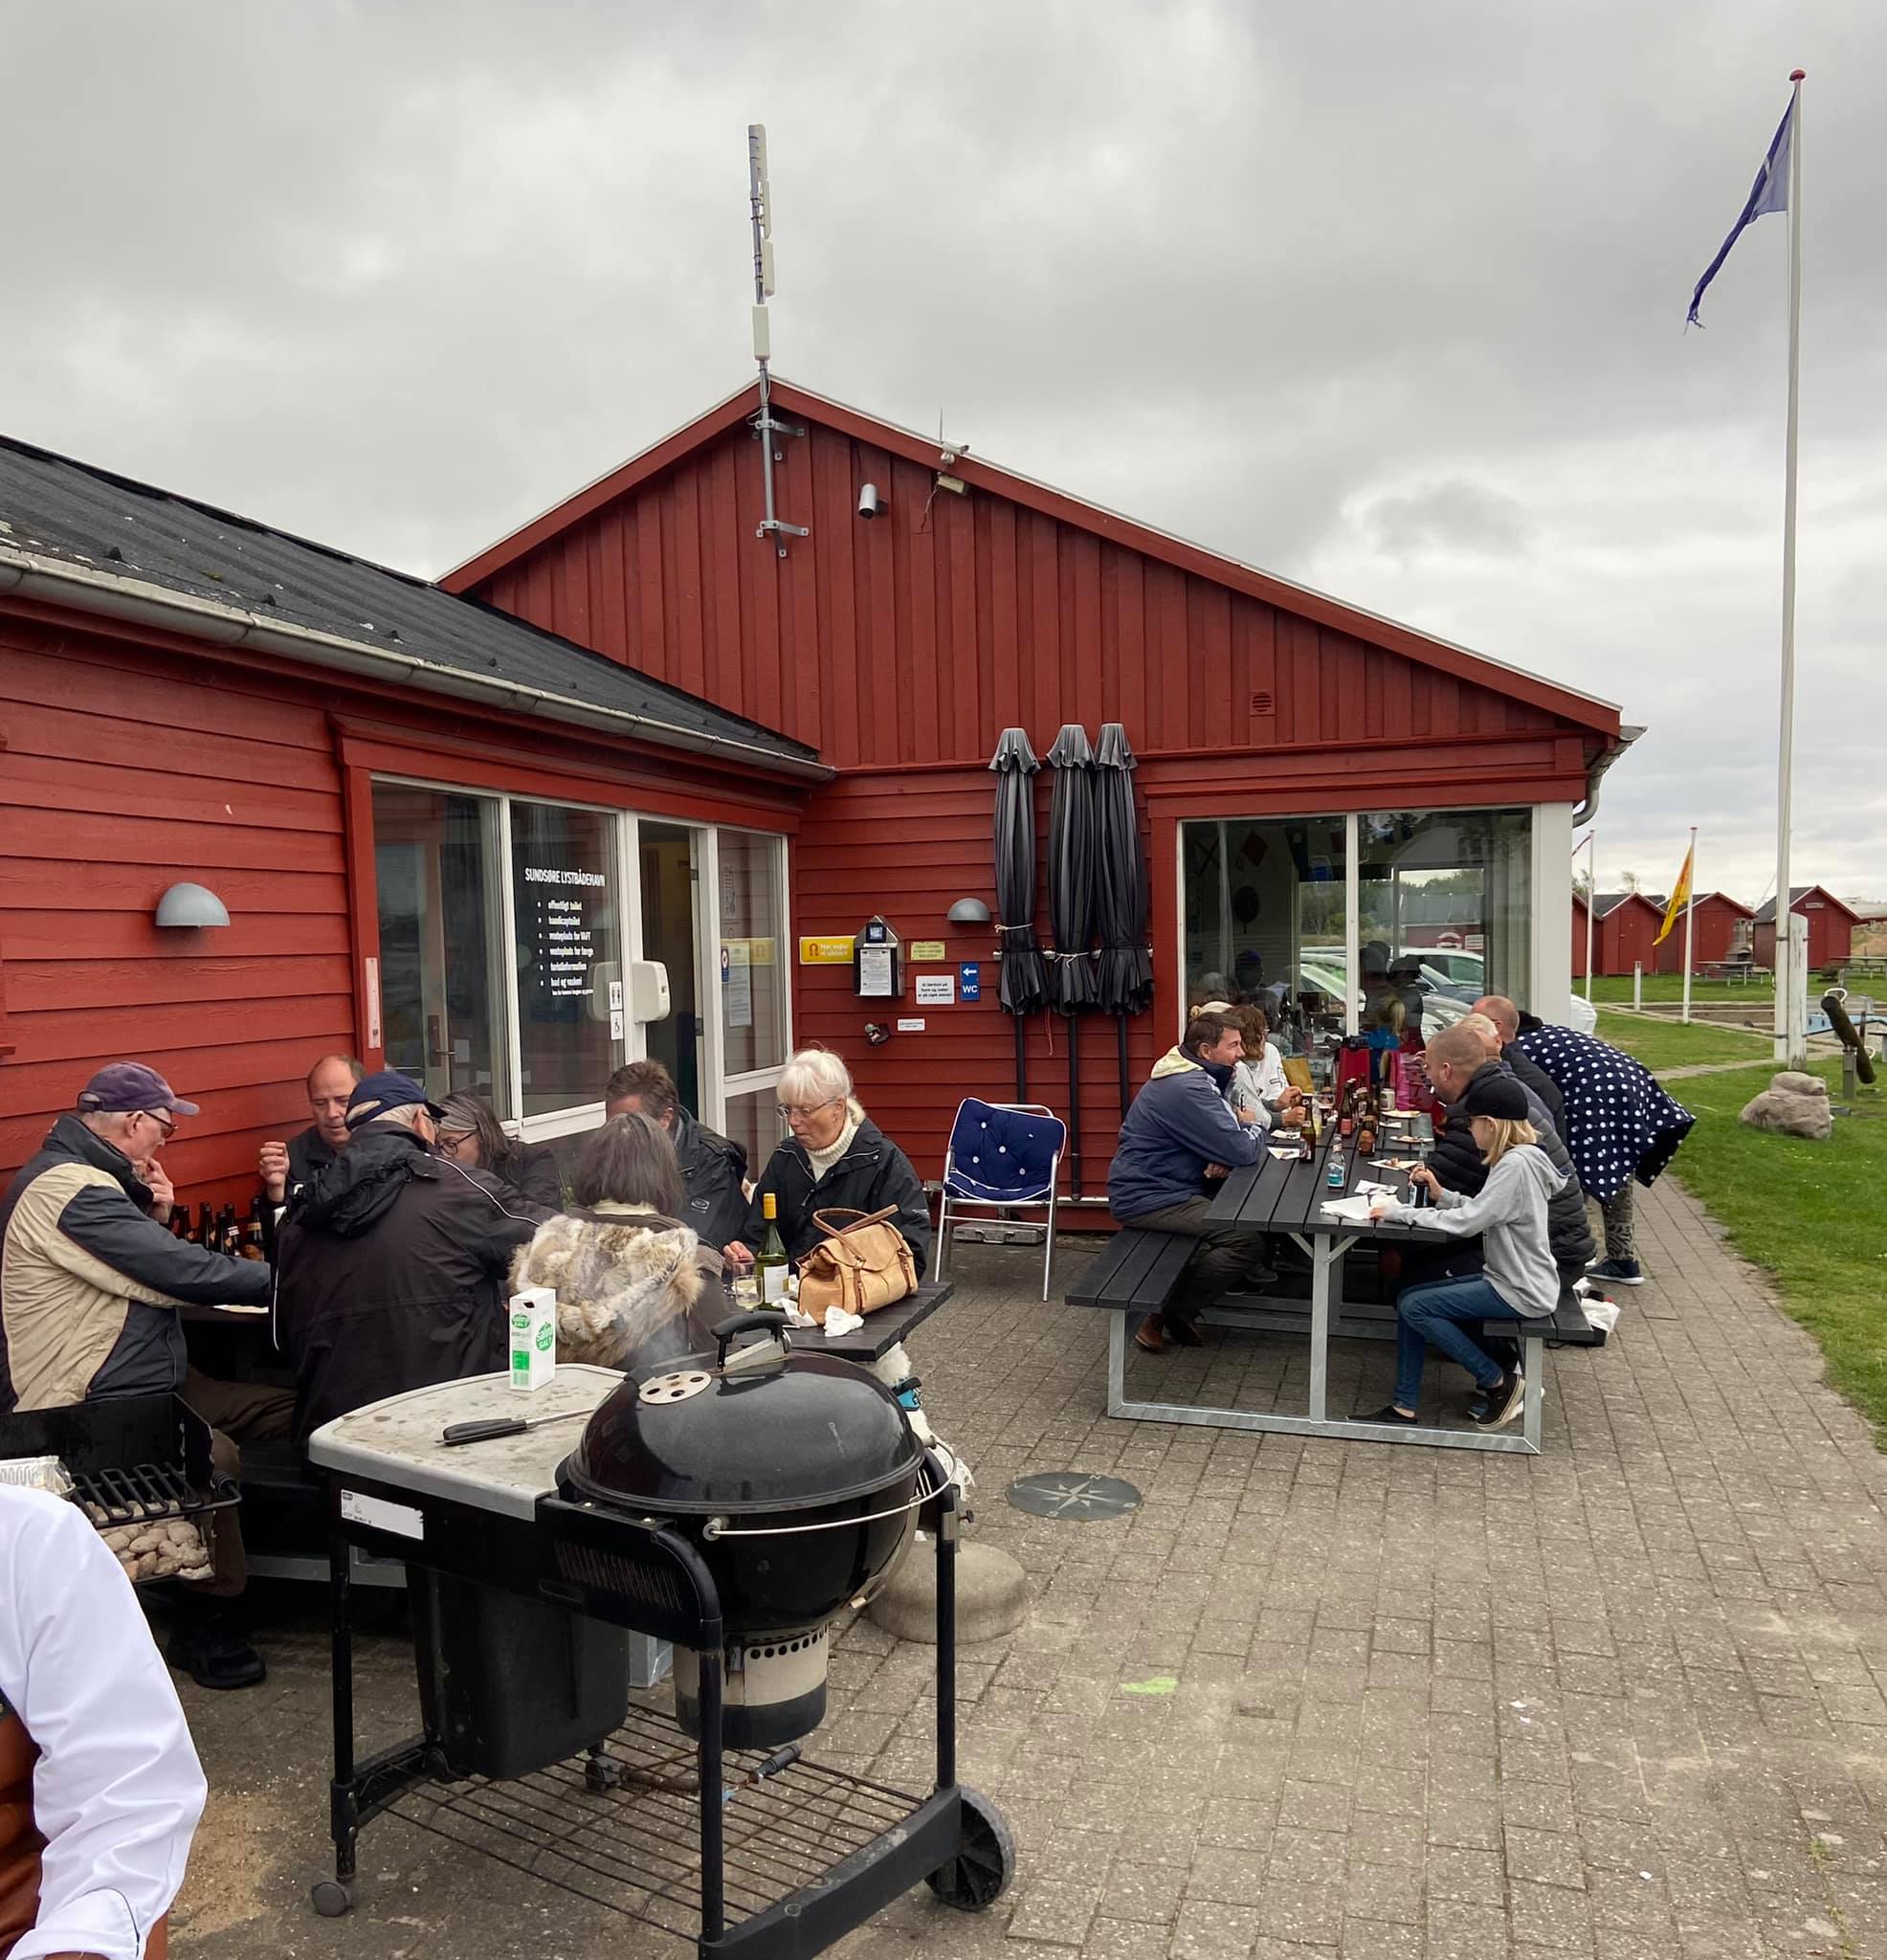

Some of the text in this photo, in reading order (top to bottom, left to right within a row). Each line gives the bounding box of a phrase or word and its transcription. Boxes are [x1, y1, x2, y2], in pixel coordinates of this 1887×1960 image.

[524, 867, 606, 887] SUNDSØRE LYSTBÅDEHAVN
[962, 985, 978, 993] WC
